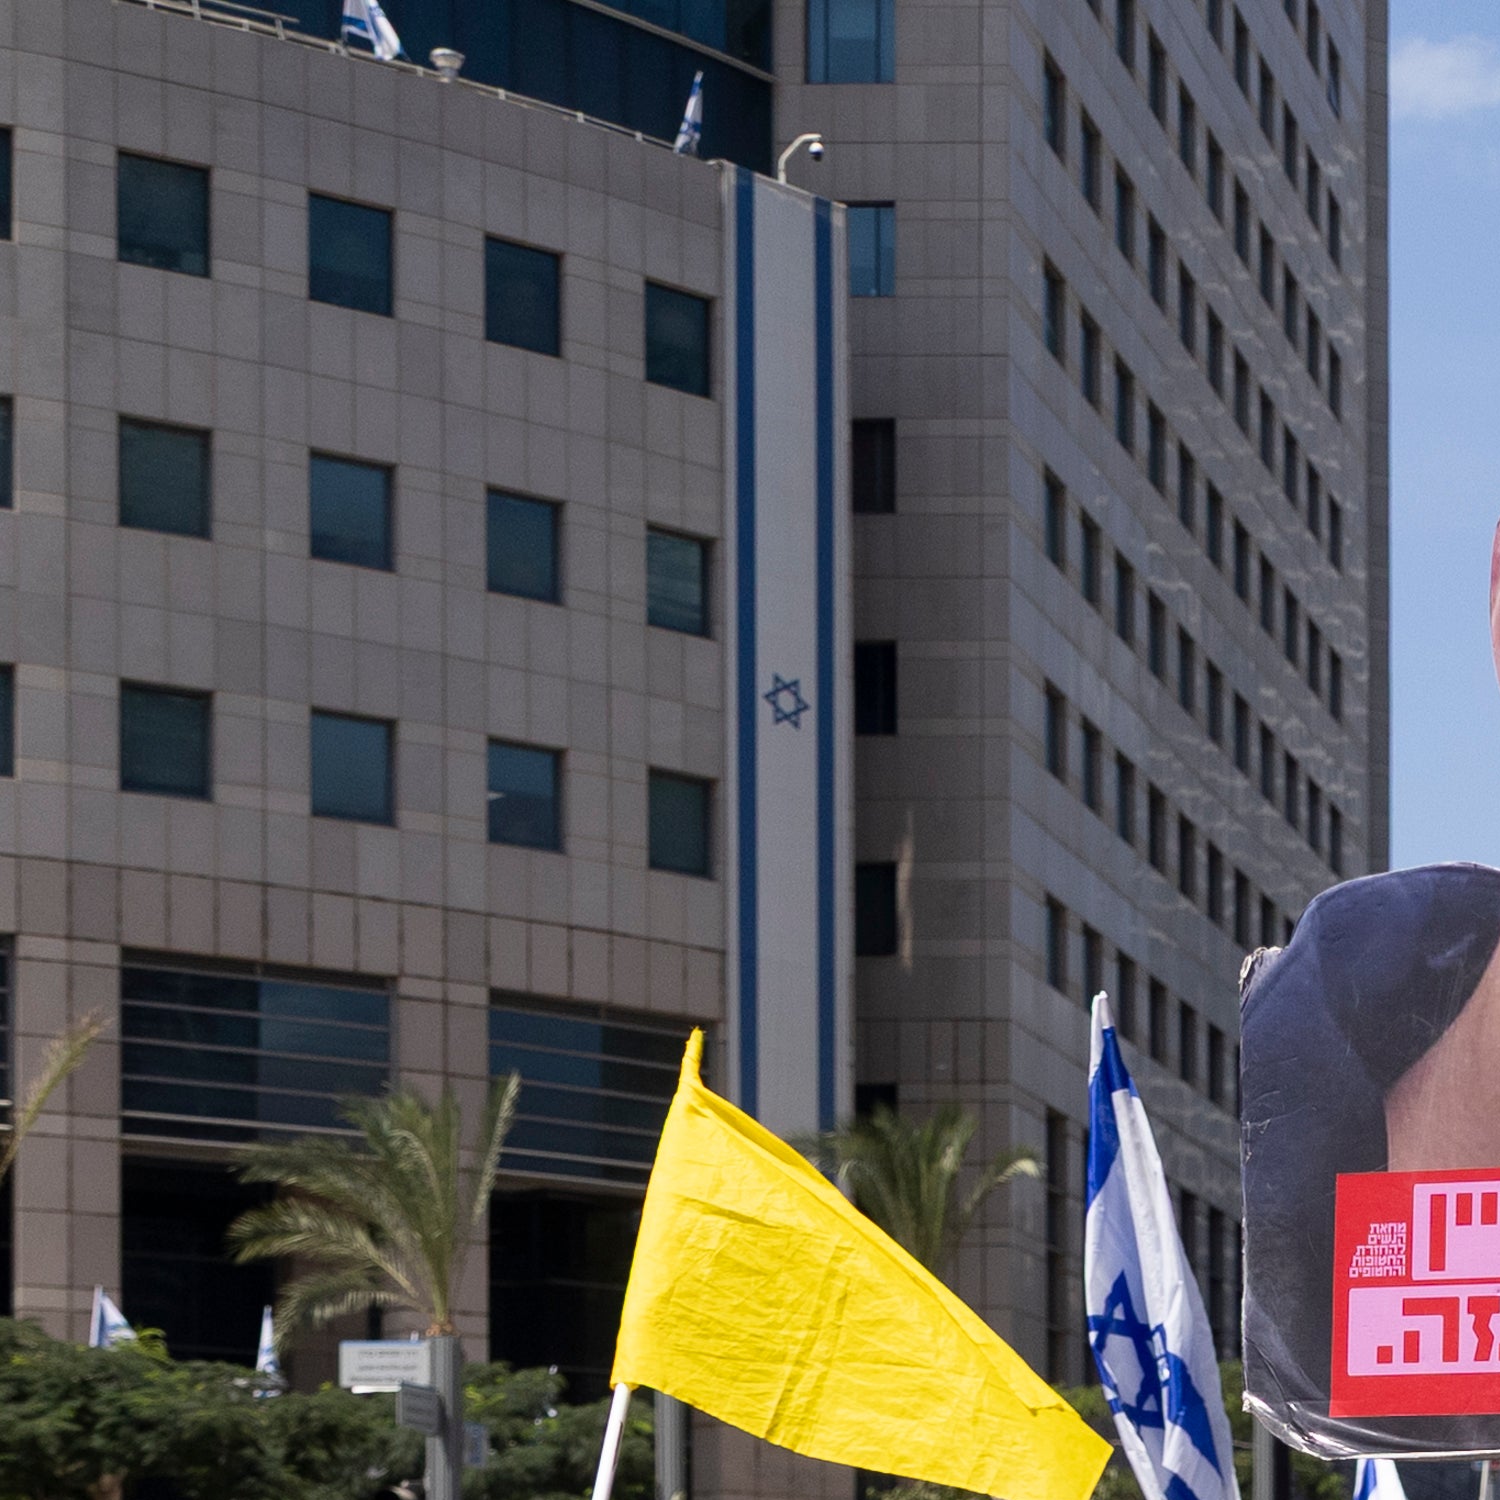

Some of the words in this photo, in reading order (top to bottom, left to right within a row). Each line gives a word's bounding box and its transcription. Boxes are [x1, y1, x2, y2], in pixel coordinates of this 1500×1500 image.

[1370, 1222, 1406, 1234] מחאת
[1368, 1233, 1406, 1246] הנשים
[1351, 1255, 1406, 1266] החטופות
[1348, 1266, 1406, 1278] והחטופים
